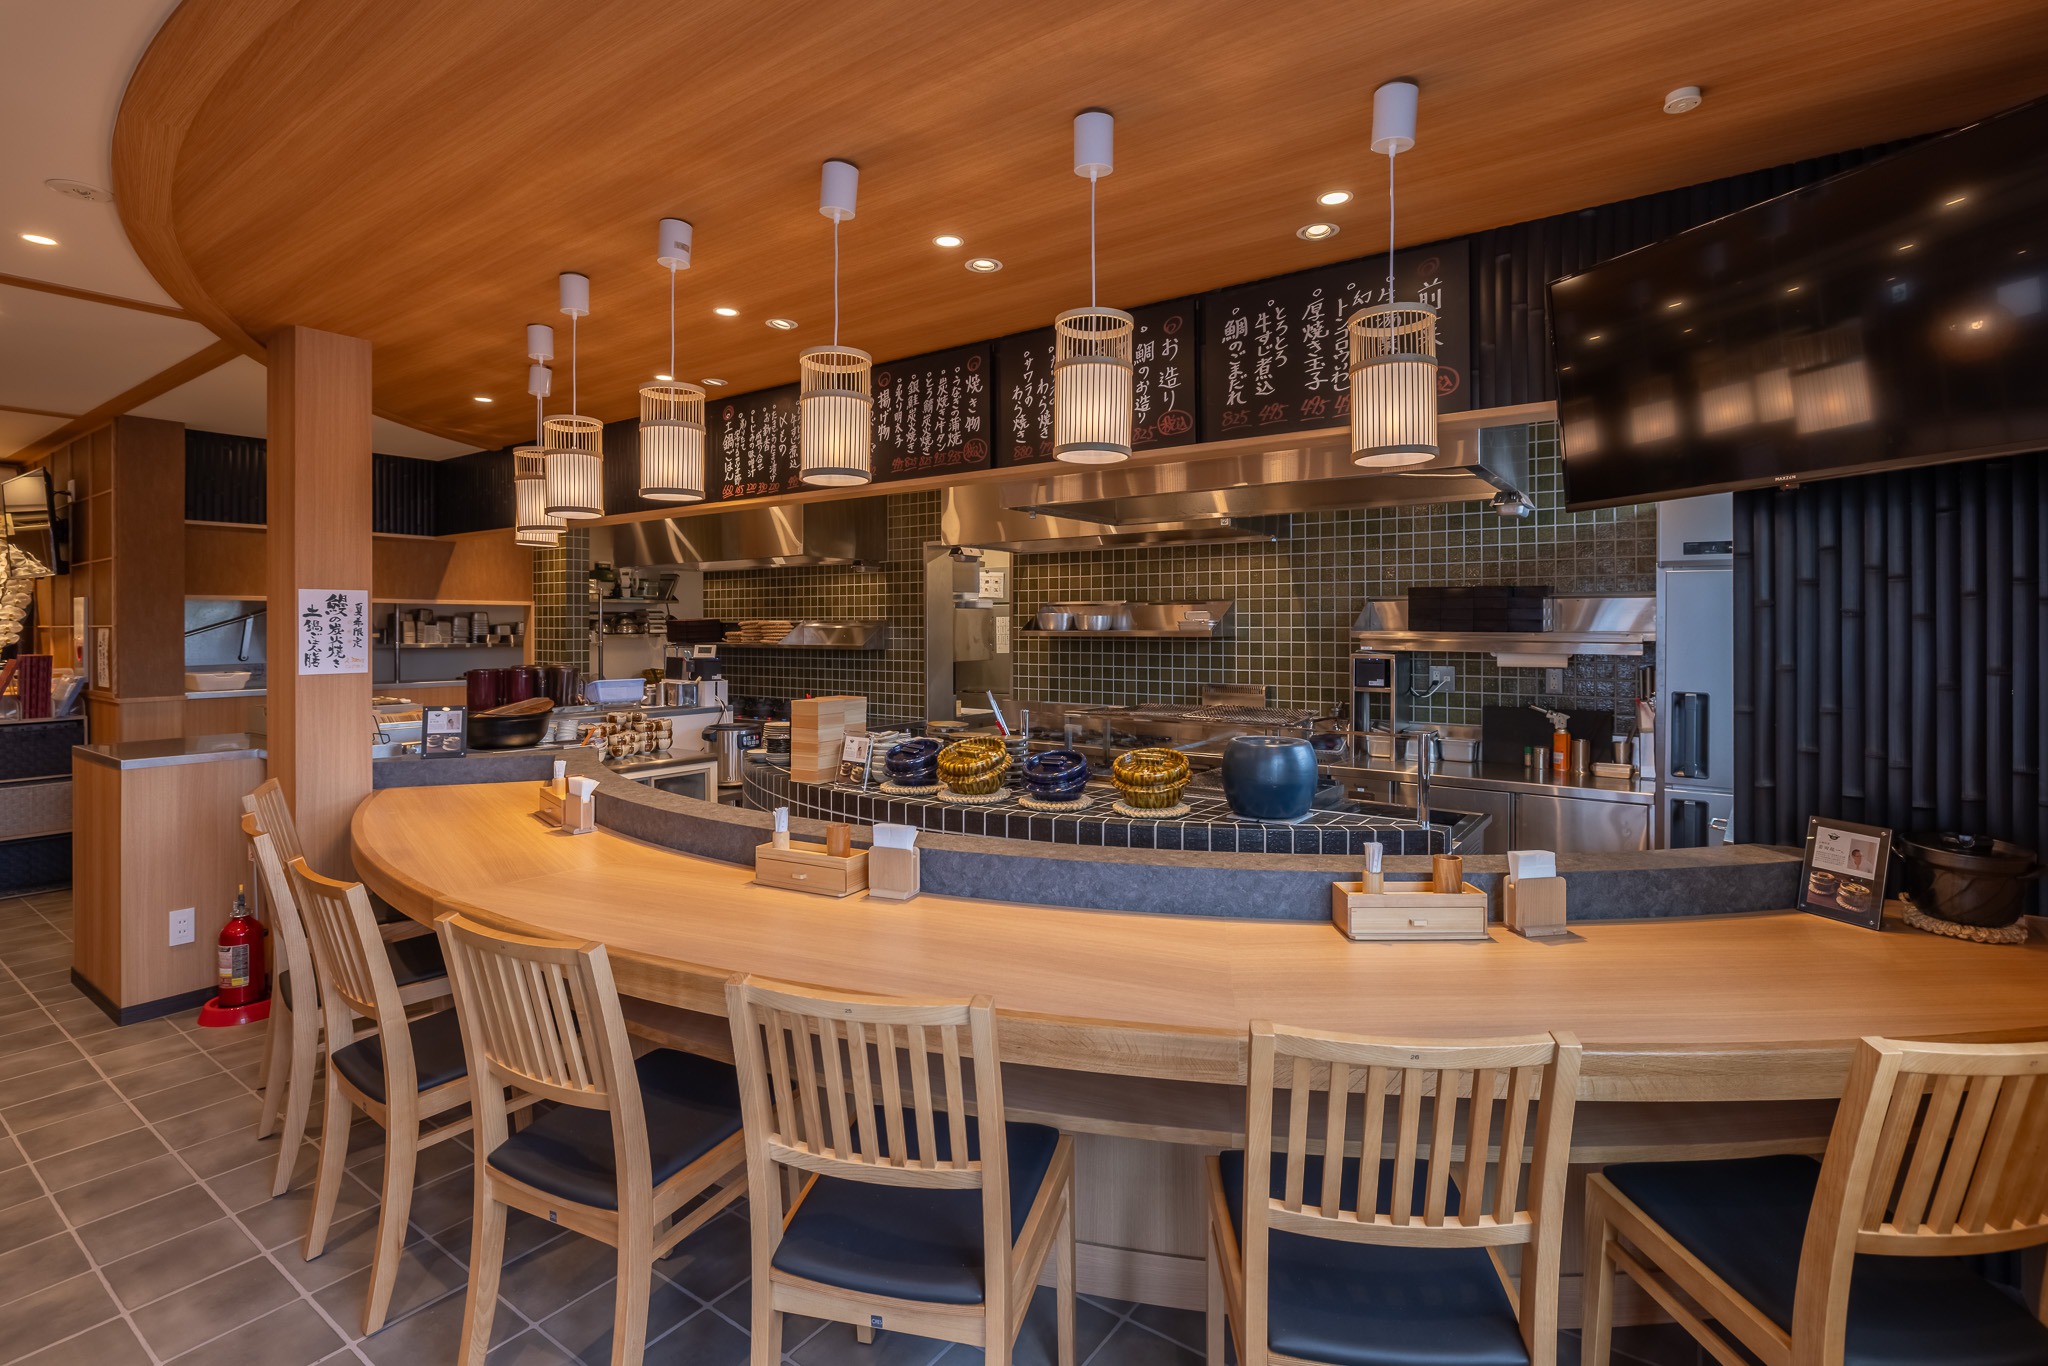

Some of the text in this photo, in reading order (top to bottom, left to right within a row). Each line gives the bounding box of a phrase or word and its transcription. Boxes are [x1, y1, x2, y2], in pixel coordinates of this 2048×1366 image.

[1275, 307, 1288, 367] とろとろ
[1417, 278, 1444, 346] 前
[1222, 316, 1248, 407] 鯛のごまだれ
[1254, 312, 1275, 396] 牛すじ煮込
[1302, 297, 1329, 390] 厚焼き玉子
[965, 374, 983, 432] 焼き物
[1134, 341, 1155, 424] 鯛のお造り
[1158, 338, 1181, 412] お造り
[1334, 394, 1350, 413] 49
[878, 389, 891, 441] 揚げ物
[1012, 386, 1030, 444] わら焼き
[1222, 411, 1249, 426] 825
[1258, 403, 1288, 420] 495
[1300, 396, 1331, 416] 495
[302, 603, 323, 668] 土鍋ごはん膳
[325, 593, 348, 668] 鰻の炭火焼き
[353, 602, 364, 648] 夏季限定
